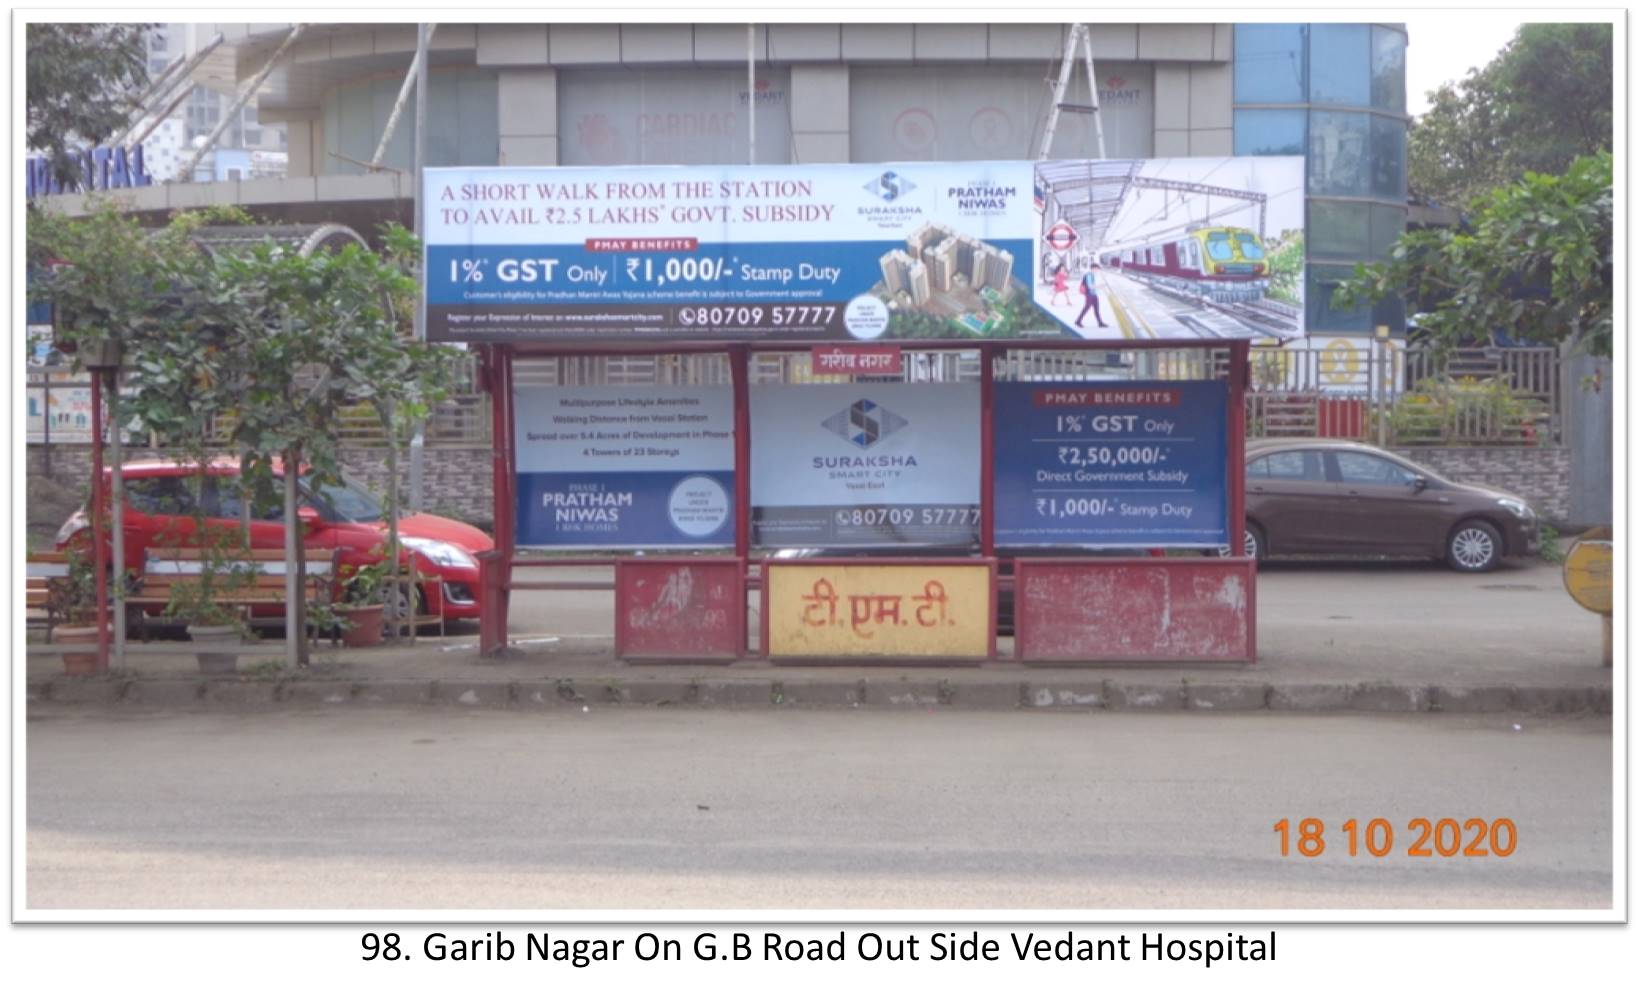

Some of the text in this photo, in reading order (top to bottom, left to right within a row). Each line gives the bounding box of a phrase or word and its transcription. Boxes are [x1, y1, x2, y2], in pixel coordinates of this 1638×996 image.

[635, 112, 737, 136] CARDIAC
[441, 181, 812, 201] A SHORT WALK FROM THE STATION
[947, 186, 1017, 198] PRATHAM
[857, 206, 922, 215] SURAKSHA
[957, 199, 1007, 210] NIWAS
[441, 208, 470, 225] TO
[474, 208, 539, 225] AVAIL
[545, 207, 582, 225] ₹2.5
[671, 206, 737, 223] GOVT.
[743, 204, 836, 223] SUBSIDY
[594, 238, 691, 250] PMAY BENEFITS
[496, 259, 559, 283] GST
[566, 264, 608, 286] Only
[741, 264, 793, 286] Stamp
[798, 262, 841, 285] Duty
[696, 306, 836, 325] 80709 57777
[819, 348, 893, 369] गरीब नगर
[559, 397, 700, 409] Multipurpose Lifestyle Amenities
[1045, 392, 1172, 404] PMAY BENEFITS
[552, 413, 709, 425] Walking Distance from Vasai Station
[1091, 415, 1139, 433] GST
[1144, 419, 1174, 435] Only
[526, 432, 558, 441] Spread
[596, 431, 621, 440] Acres
[622, 431, 632, 440] of
[632, 431, 691, 441] Development
[692, 431, 700, 439] in
[702, 430, 729, 439] Phase
[583, 447, 680, 459] 4 Towers of 23 Storeys
[813, 455, 918, 469] SURAKSHA
[829, 470, 901, 479] SMART CITY
[1036, 469, 1189, 485] Direct Government Subsidy
[542, 492, 633, 506] PRATHAM
[555, 508, 619, 522] NIWAS
[851, 508, 980, 525] 80709 57777
[1120, 503, 1158, 519] Stamp
[1161, 501, 1193, 519] Duty
